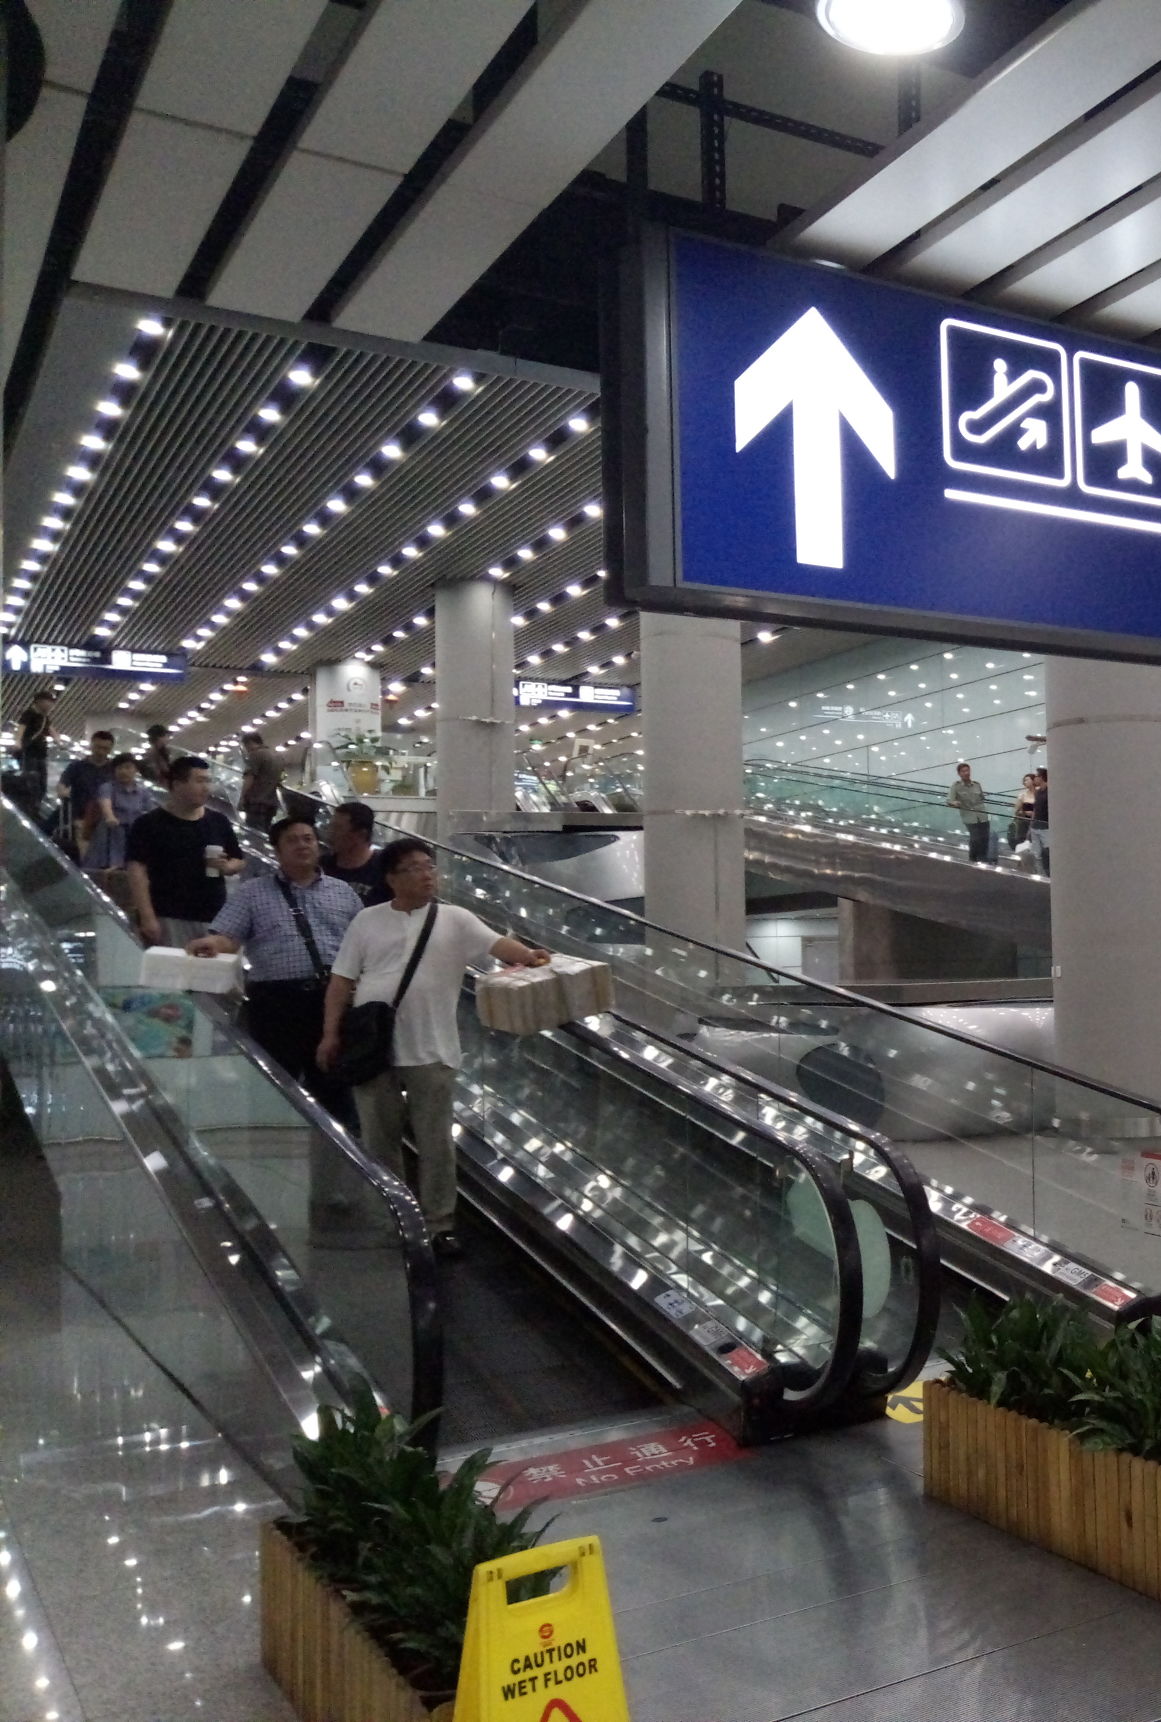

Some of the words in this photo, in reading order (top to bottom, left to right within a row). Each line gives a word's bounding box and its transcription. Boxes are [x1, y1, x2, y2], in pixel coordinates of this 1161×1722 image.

[522, 1431, 717, 1483] 禁止通行
[575, 1472, 619, 1487] No
[624, 1456, 695, 1477] Entry
[510, 1638, 587, 1676] CAUTION
[501, 1676, 539, 1702] WET
[543, 1657, 599, 1689] FLOOR
